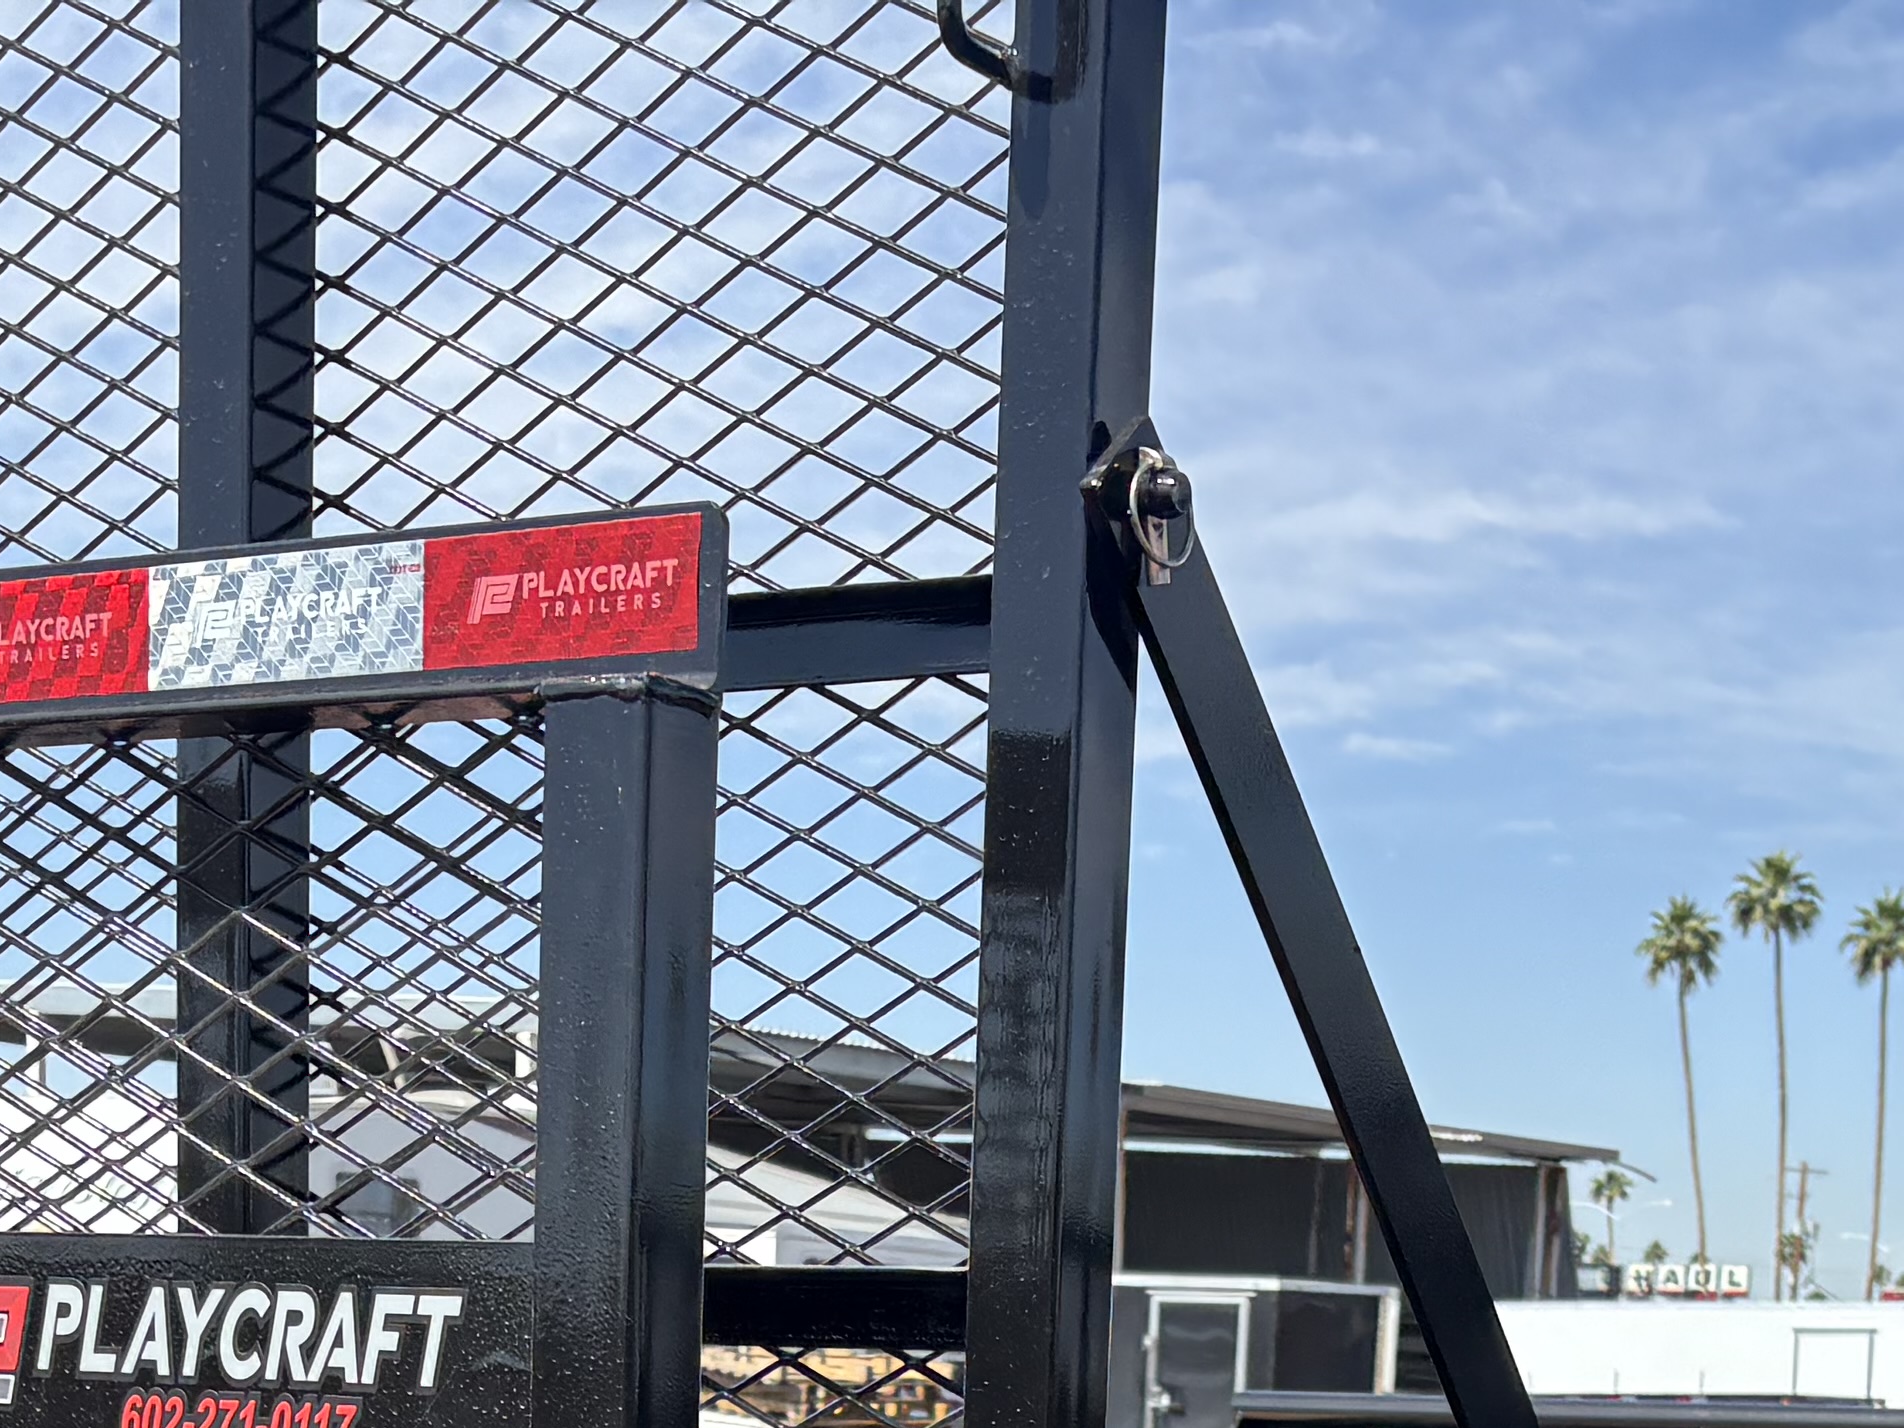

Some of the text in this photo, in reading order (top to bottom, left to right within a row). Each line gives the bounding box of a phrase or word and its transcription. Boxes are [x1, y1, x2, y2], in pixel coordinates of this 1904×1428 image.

[522, 558, 678, 598] PLAYCRAFT
[240, 587, 382, 624] PLAYCRAFT
[539, 591, 662, 618] TRAILERS
[36, 1283, 463, 1388] PLAYCRAFT
